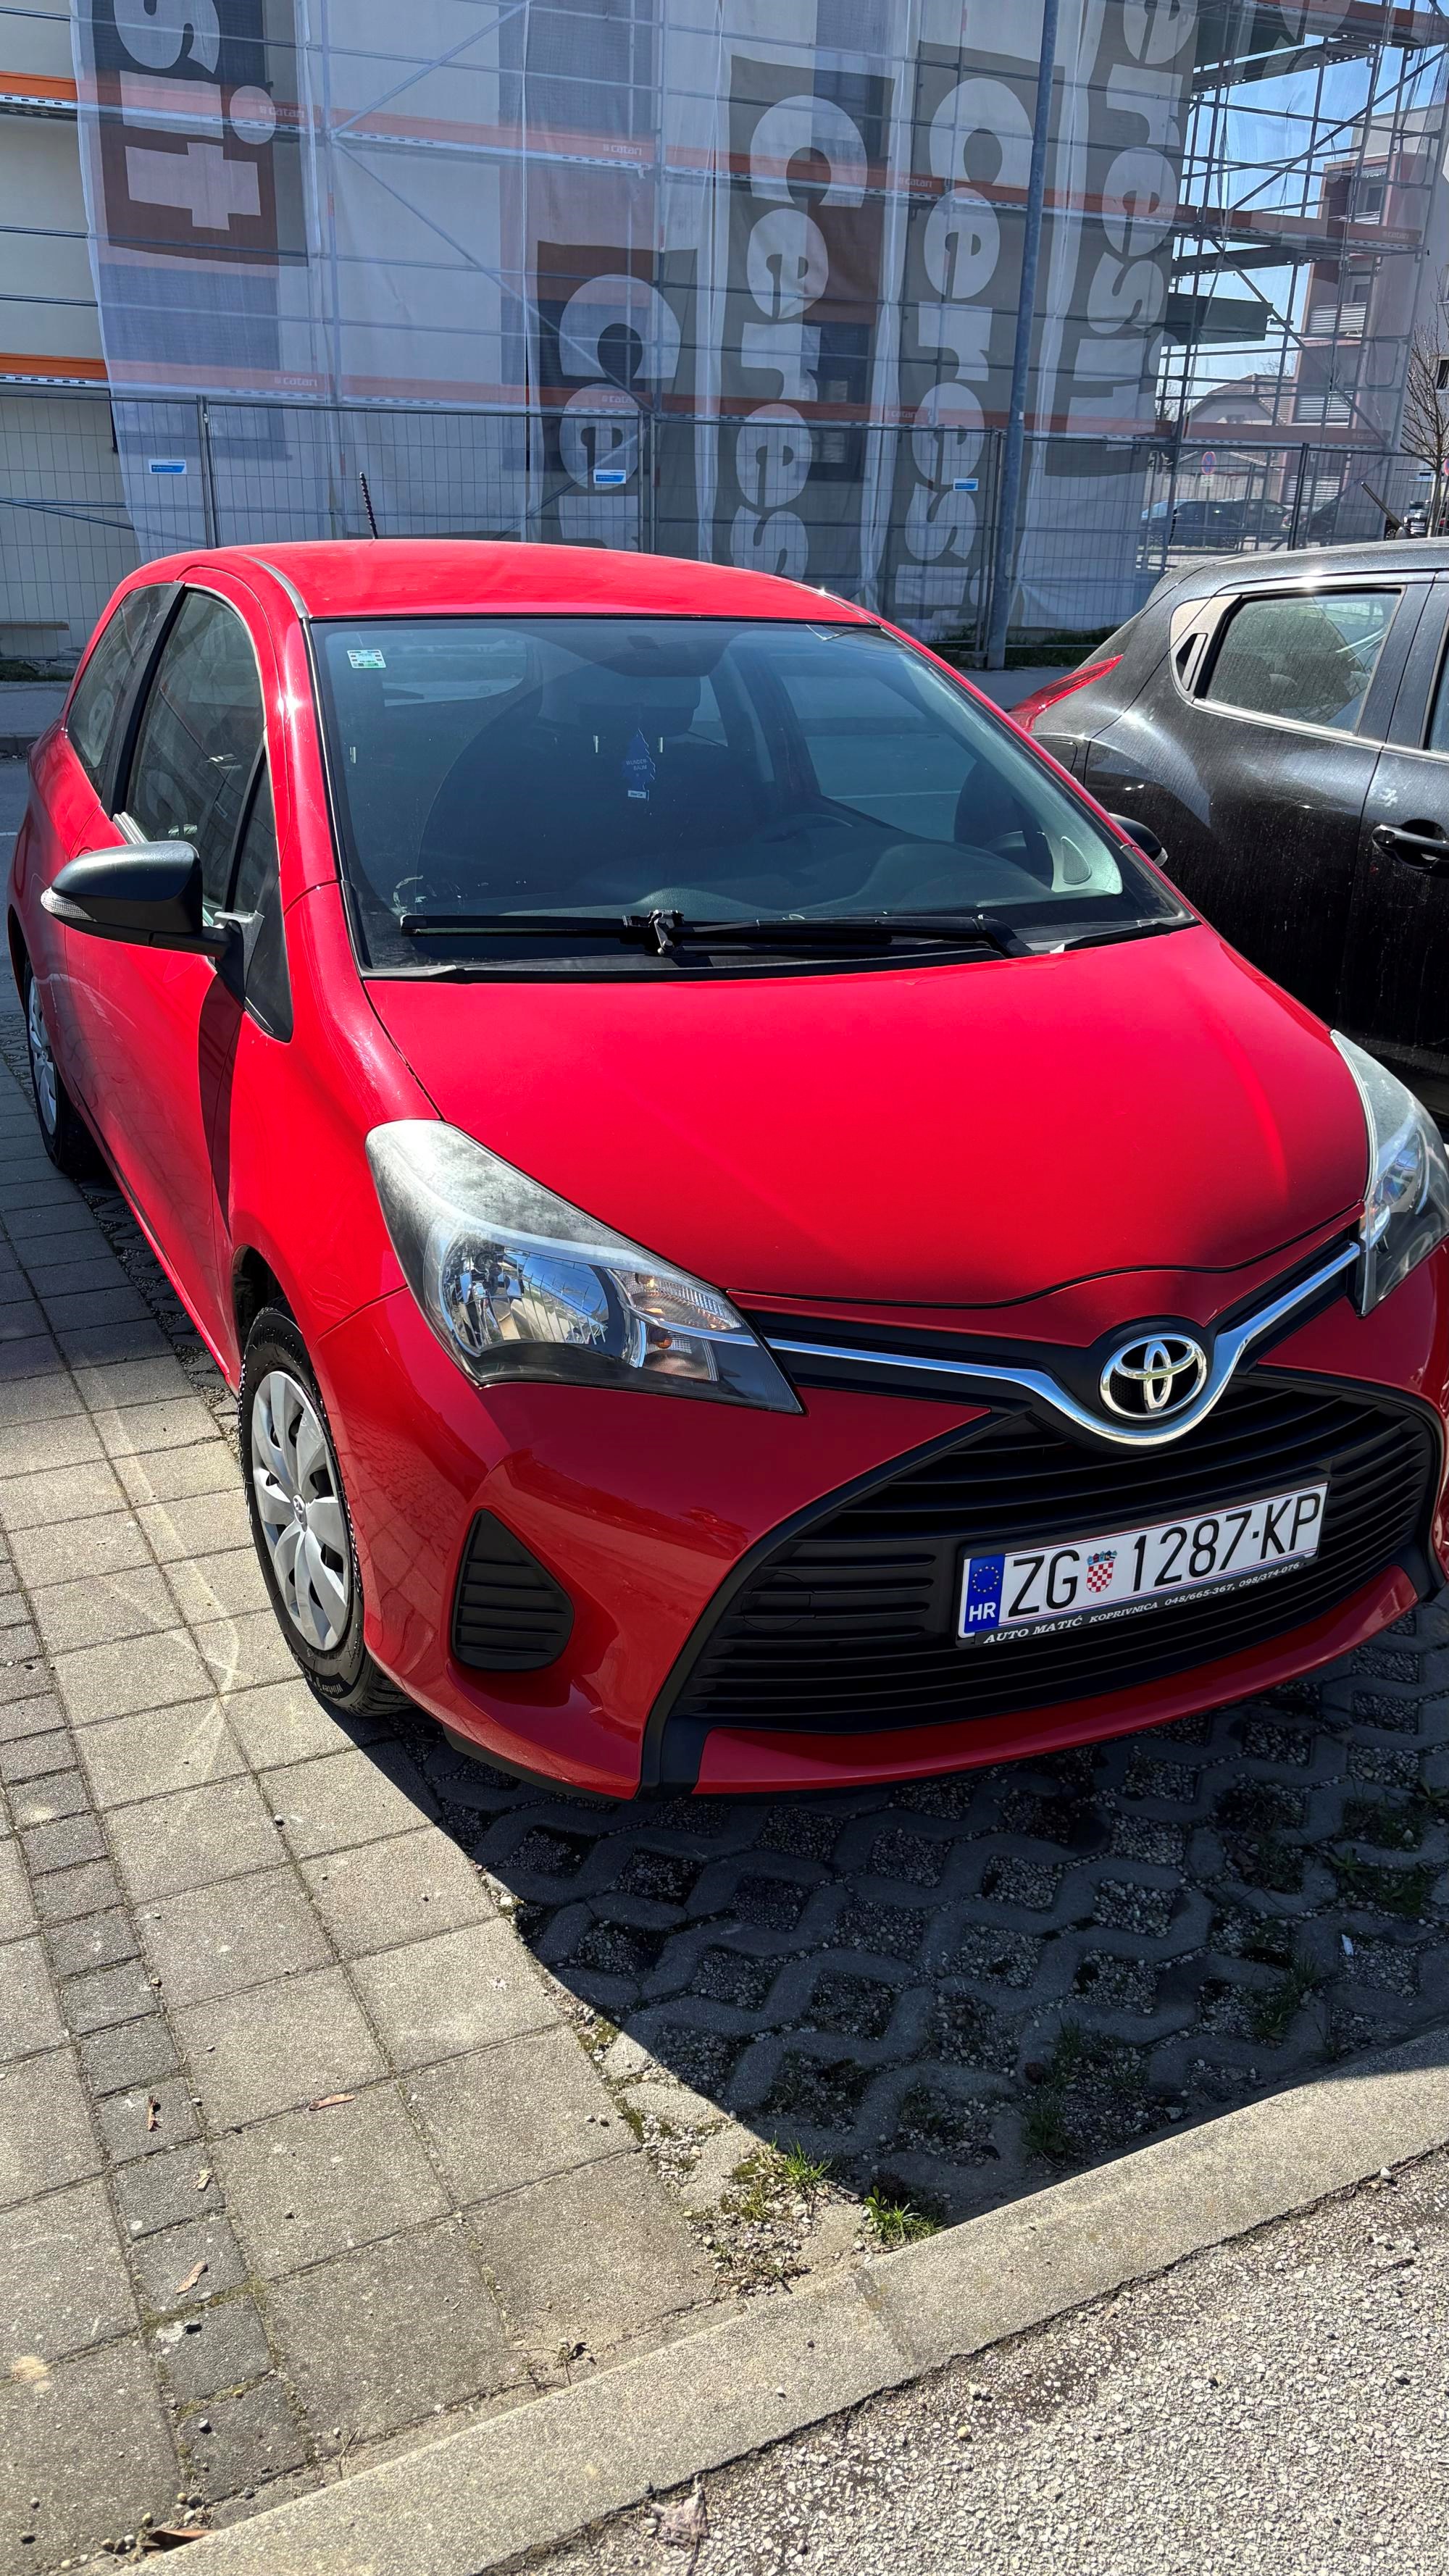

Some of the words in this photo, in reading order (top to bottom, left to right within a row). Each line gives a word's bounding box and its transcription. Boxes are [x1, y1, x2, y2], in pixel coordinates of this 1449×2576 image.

[611, 145, 642, 156] catari
[283, 377, 318, 387] catari
[1008, 1549, 1080, 1618] ZG
[969, 1602, 995, 1622] HR
[983, 1628, 1029, 1644] AUTO
[1032, 1615, 1082, 1635] MATIĆ
[1089, 1602, 1158, 1623] KOPRIVNICA
[1164, 1584, 1235, 1606] 048/665-367,
[1239, 1562, 1300, 1588] 098/374-076
